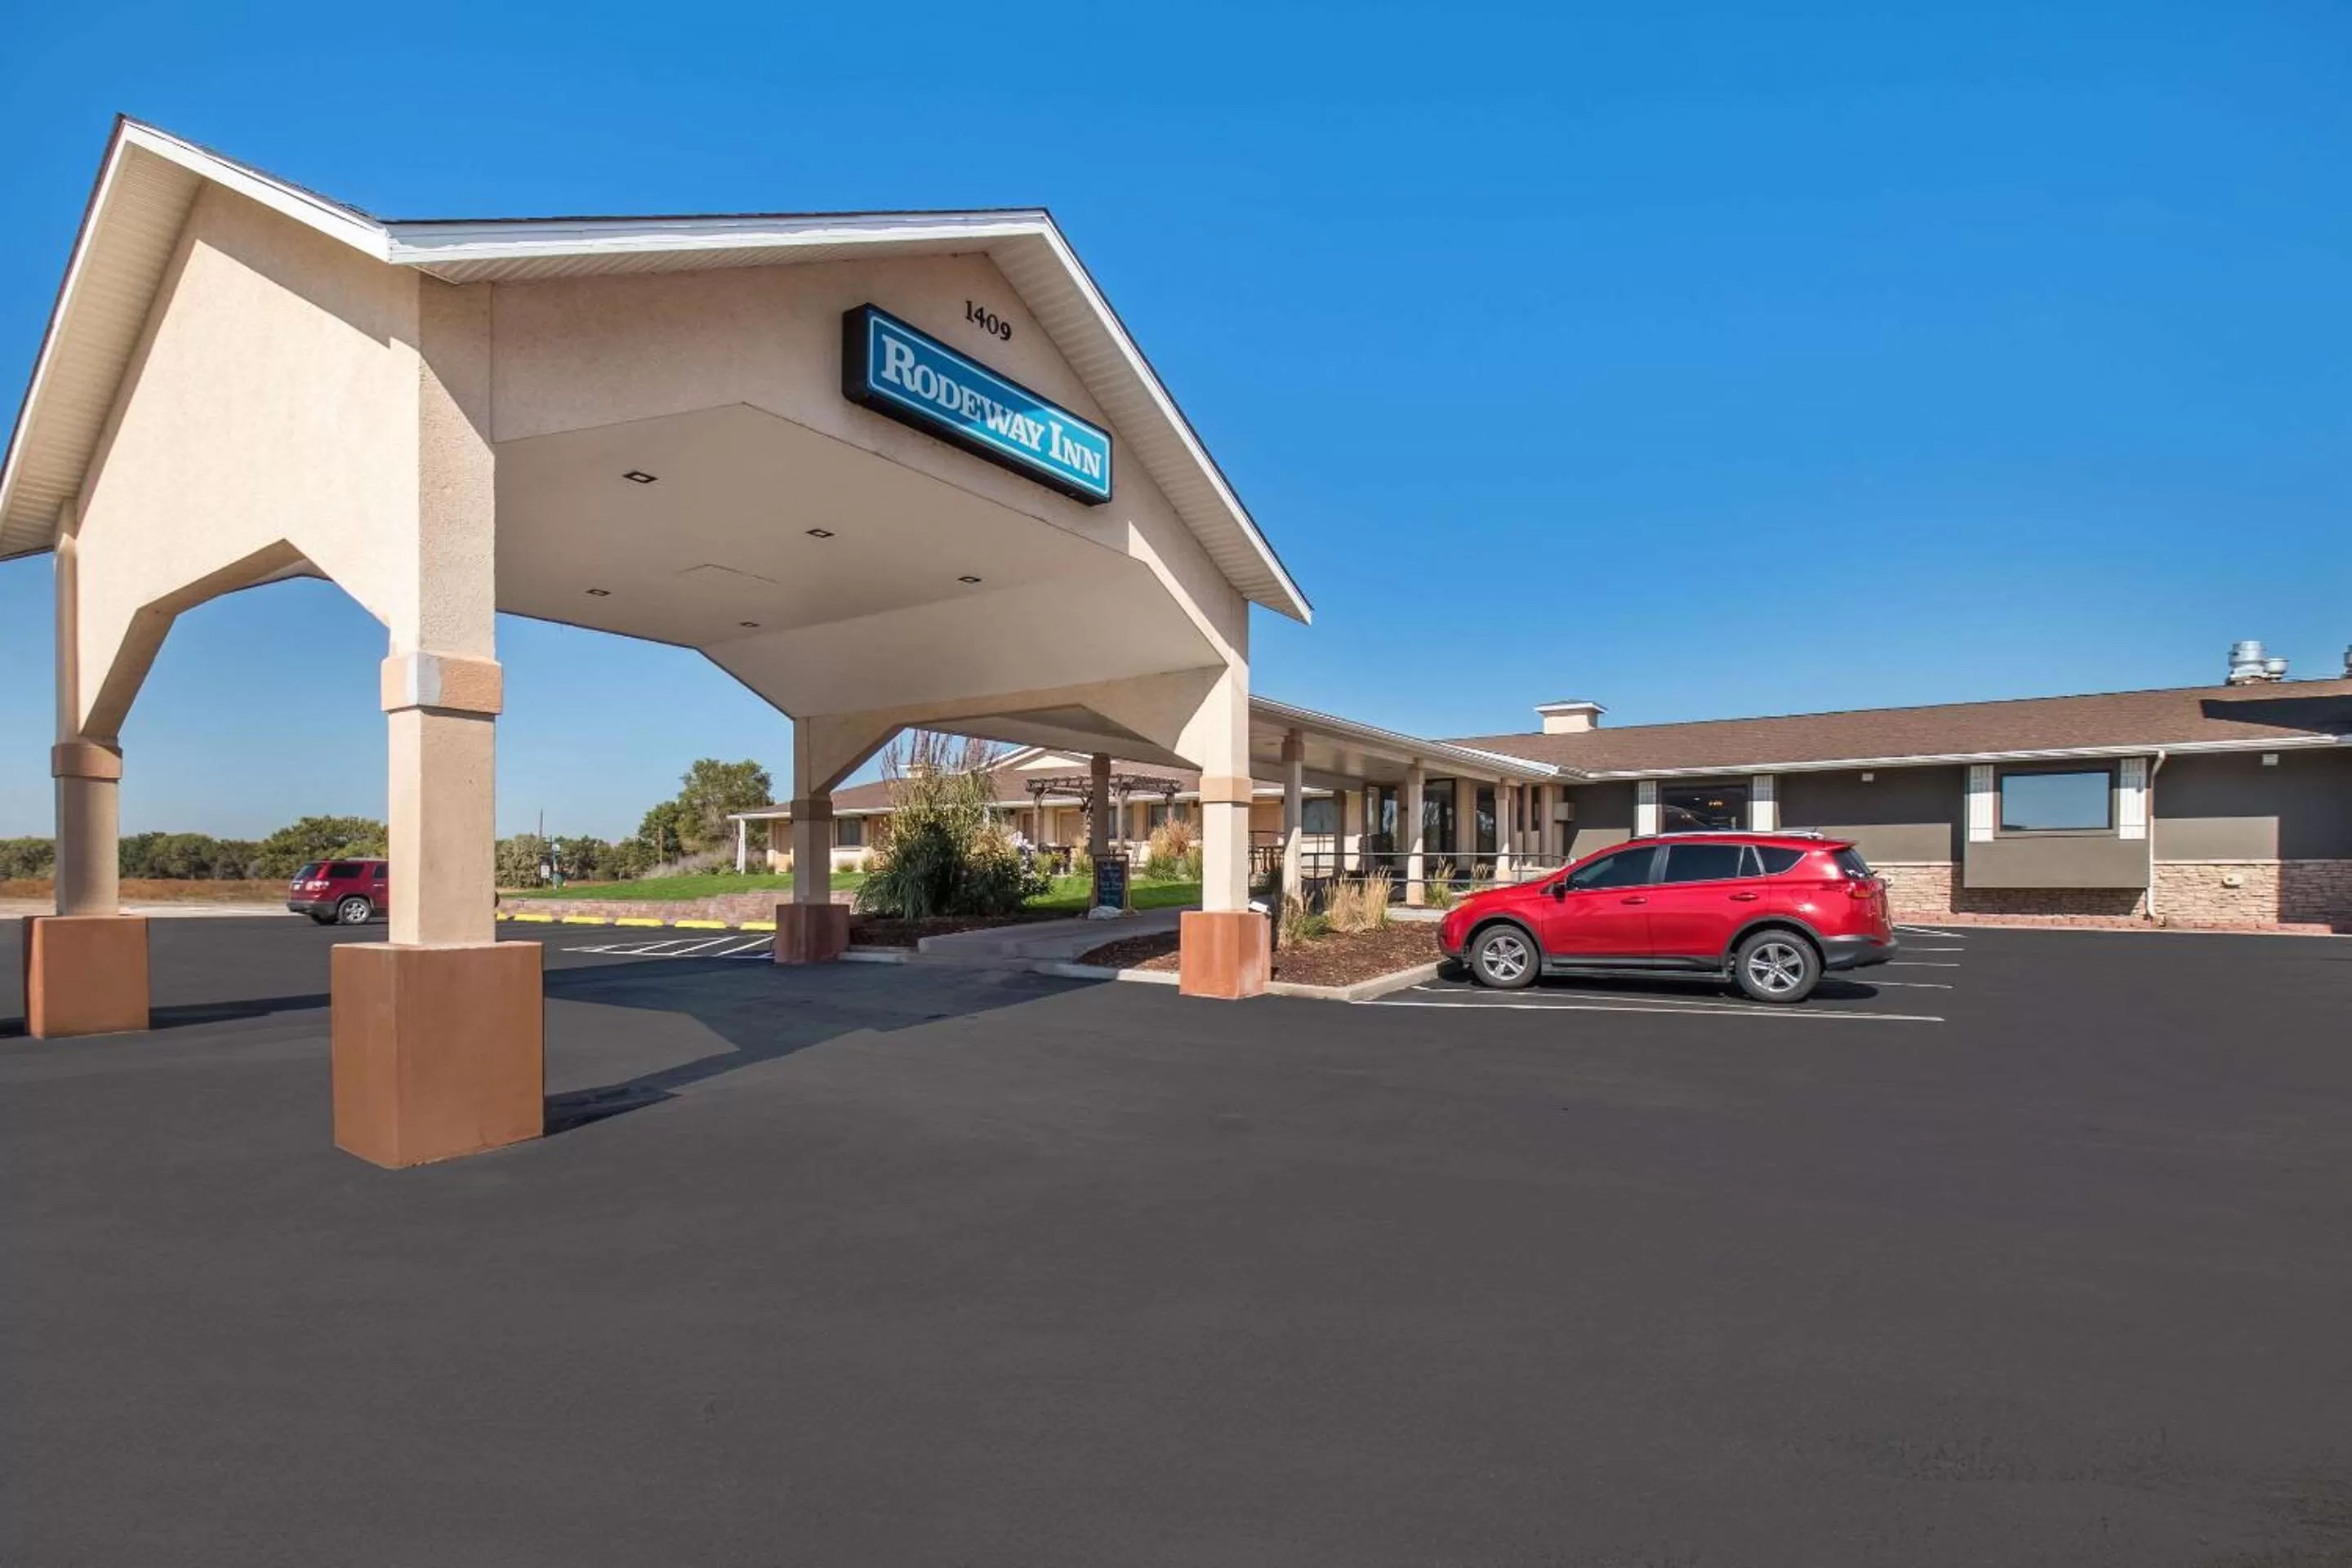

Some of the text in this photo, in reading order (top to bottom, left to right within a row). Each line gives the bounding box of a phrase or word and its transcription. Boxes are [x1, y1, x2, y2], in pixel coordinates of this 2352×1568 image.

[965, 301, 1012, 341] 1409
[881, 334, 1102, 479] RODEWAY INN
